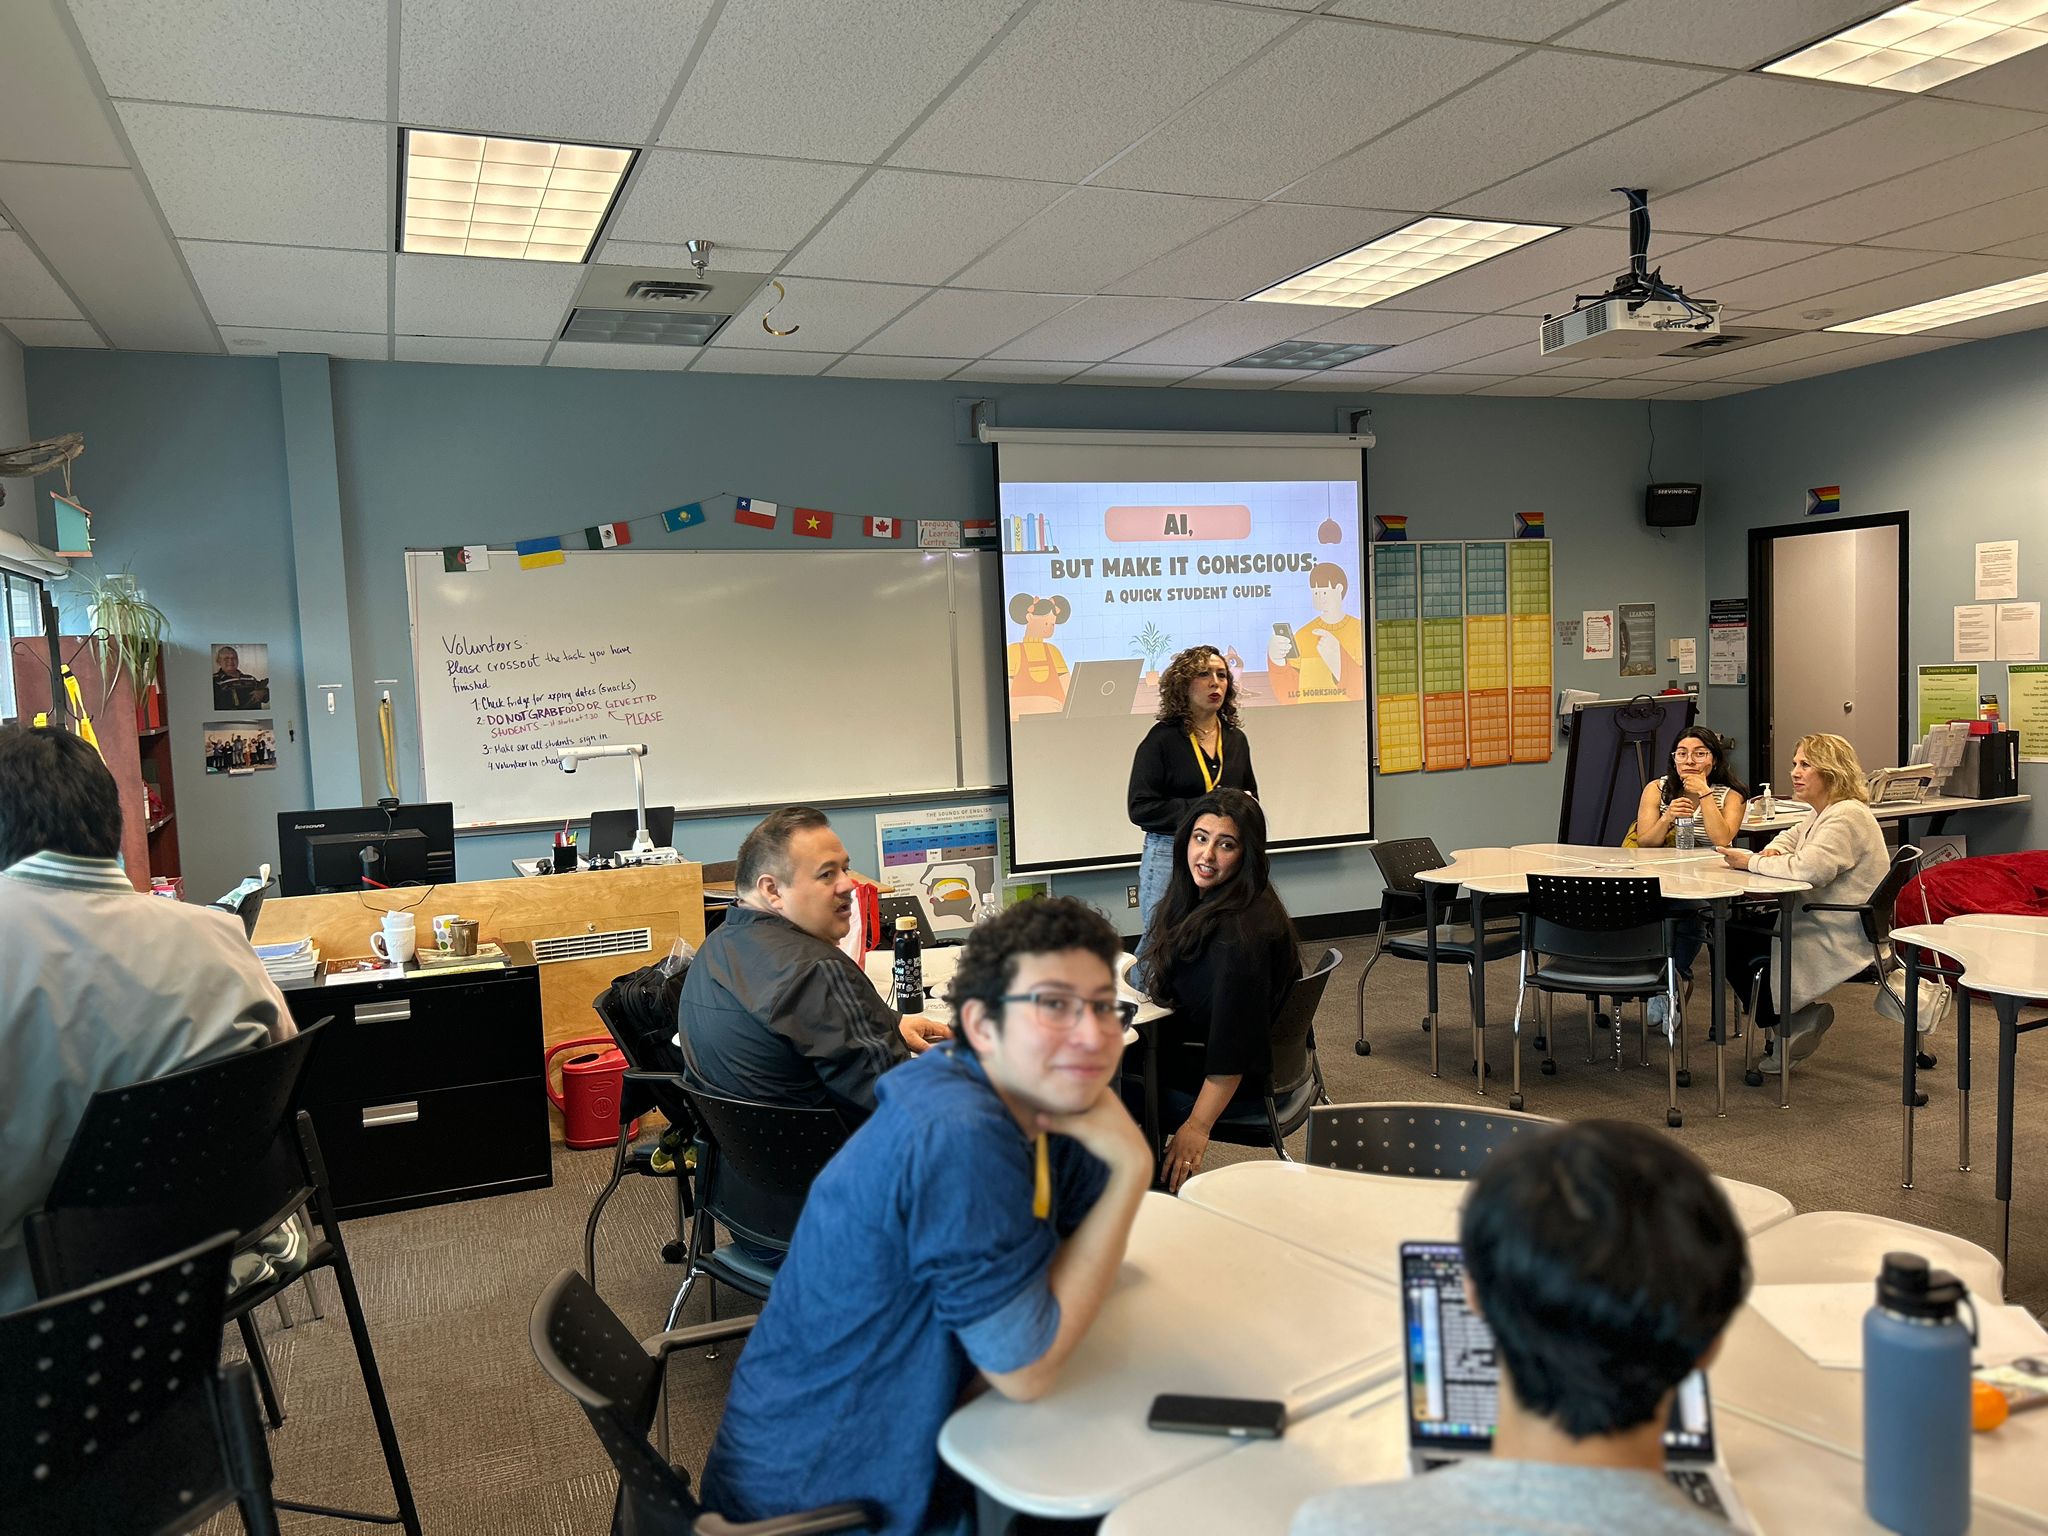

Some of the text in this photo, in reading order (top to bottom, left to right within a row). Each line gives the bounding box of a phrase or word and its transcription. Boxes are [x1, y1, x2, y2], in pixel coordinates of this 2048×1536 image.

[1164, 513, 1193, 536] AI,
[1051, 558, 1094, 579] BUT
[1102, 556, 1162, 578] MAKE
[1169, 556, 1189, 575] IT
[1105, 584, 1272, 603] A QUICK STUDENT GUIDE
[446, 660, 481, 676] Please
[545, 652, 560, 663] the
[563, 649, 586, 661] task
[589, 651, 606, 664] you
[625, 711, 664, 726] PLEASE
